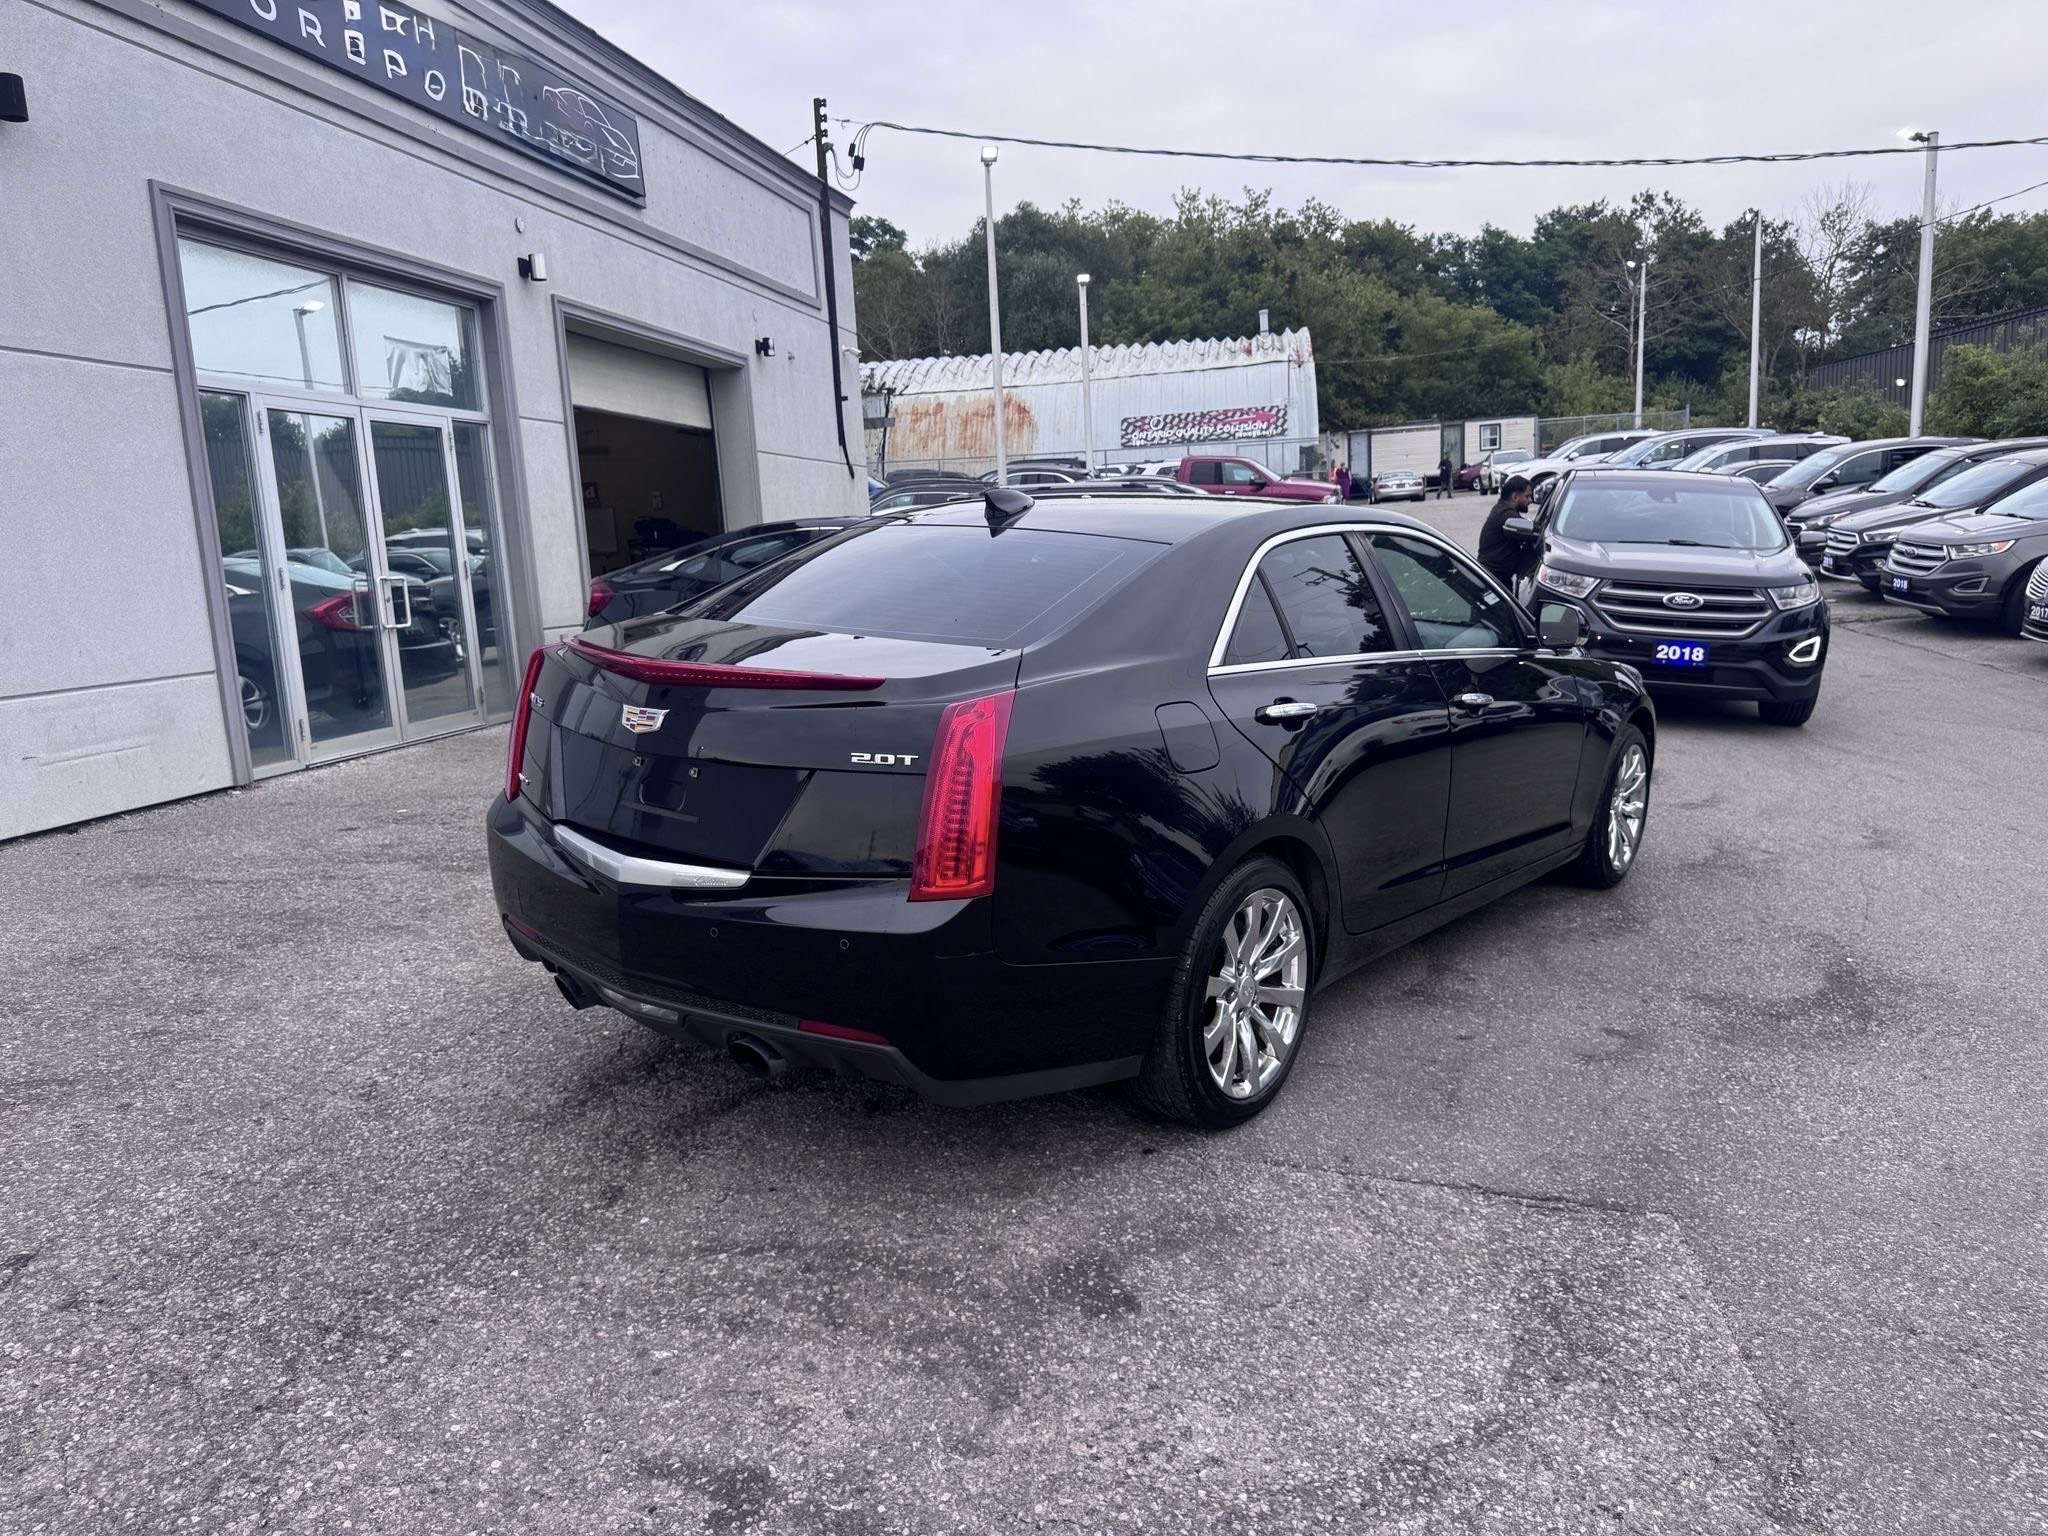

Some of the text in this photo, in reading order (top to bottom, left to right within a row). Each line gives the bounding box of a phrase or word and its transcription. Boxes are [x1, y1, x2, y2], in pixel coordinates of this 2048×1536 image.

[1131, 421, 1269, 440] ONTARIO QUALITY COLLISION
[1673, 595, 1695, 605] Ford
[1656, 644, 1704, 662] 2018
[851, 752, 919, 766] 2.0T
